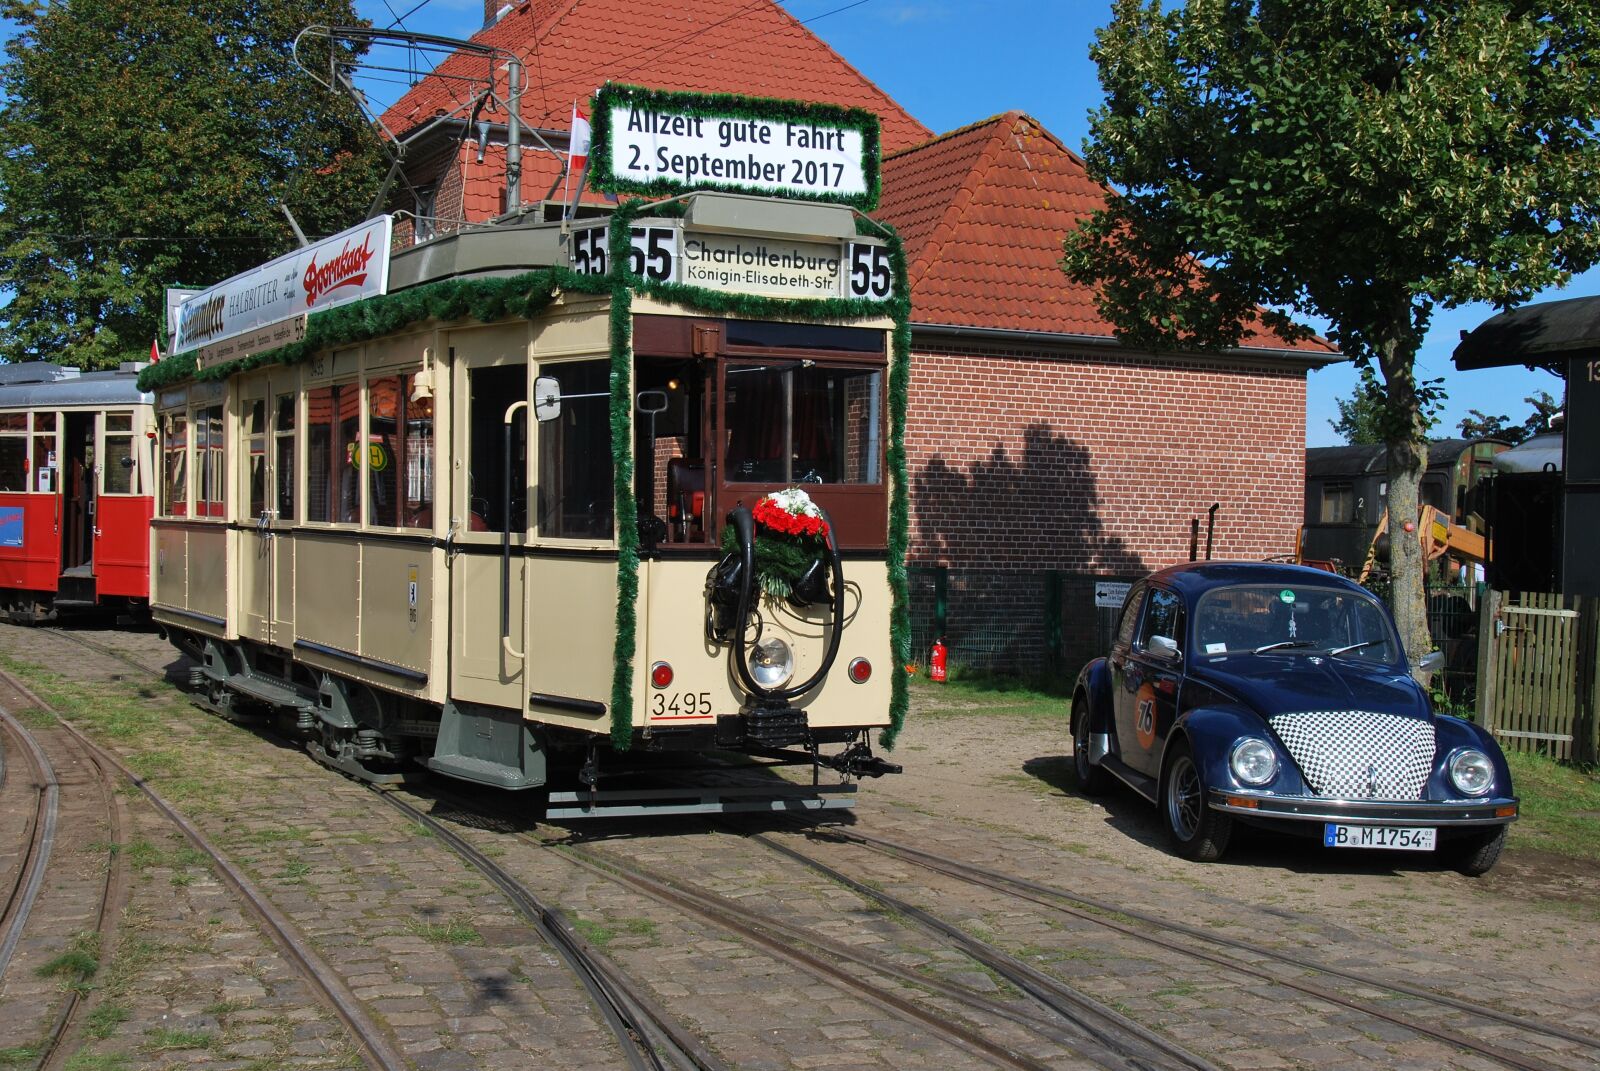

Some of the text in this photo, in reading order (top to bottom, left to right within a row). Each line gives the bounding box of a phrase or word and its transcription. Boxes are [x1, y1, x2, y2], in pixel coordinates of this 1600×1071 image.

[628, 105, 845, 151] Allzeit gute Fahrt
[628, 144, 844, 187] 2. September 2017
[574, 228, 606, 275] 55
[685, 239, 839, 278] Charlottenburg
[851, 243, 891, 297] 55
[688, 265, 834, 290] Königin-Elisabeth-Str.
[229, 278, 278, 318] HALBBITTER
[295, 315, 304, 341] 55
[652, 692, 712, 716] 3495
[1137, 700, 1154, 735] 76
[1336, 827, 1349, 844] B
